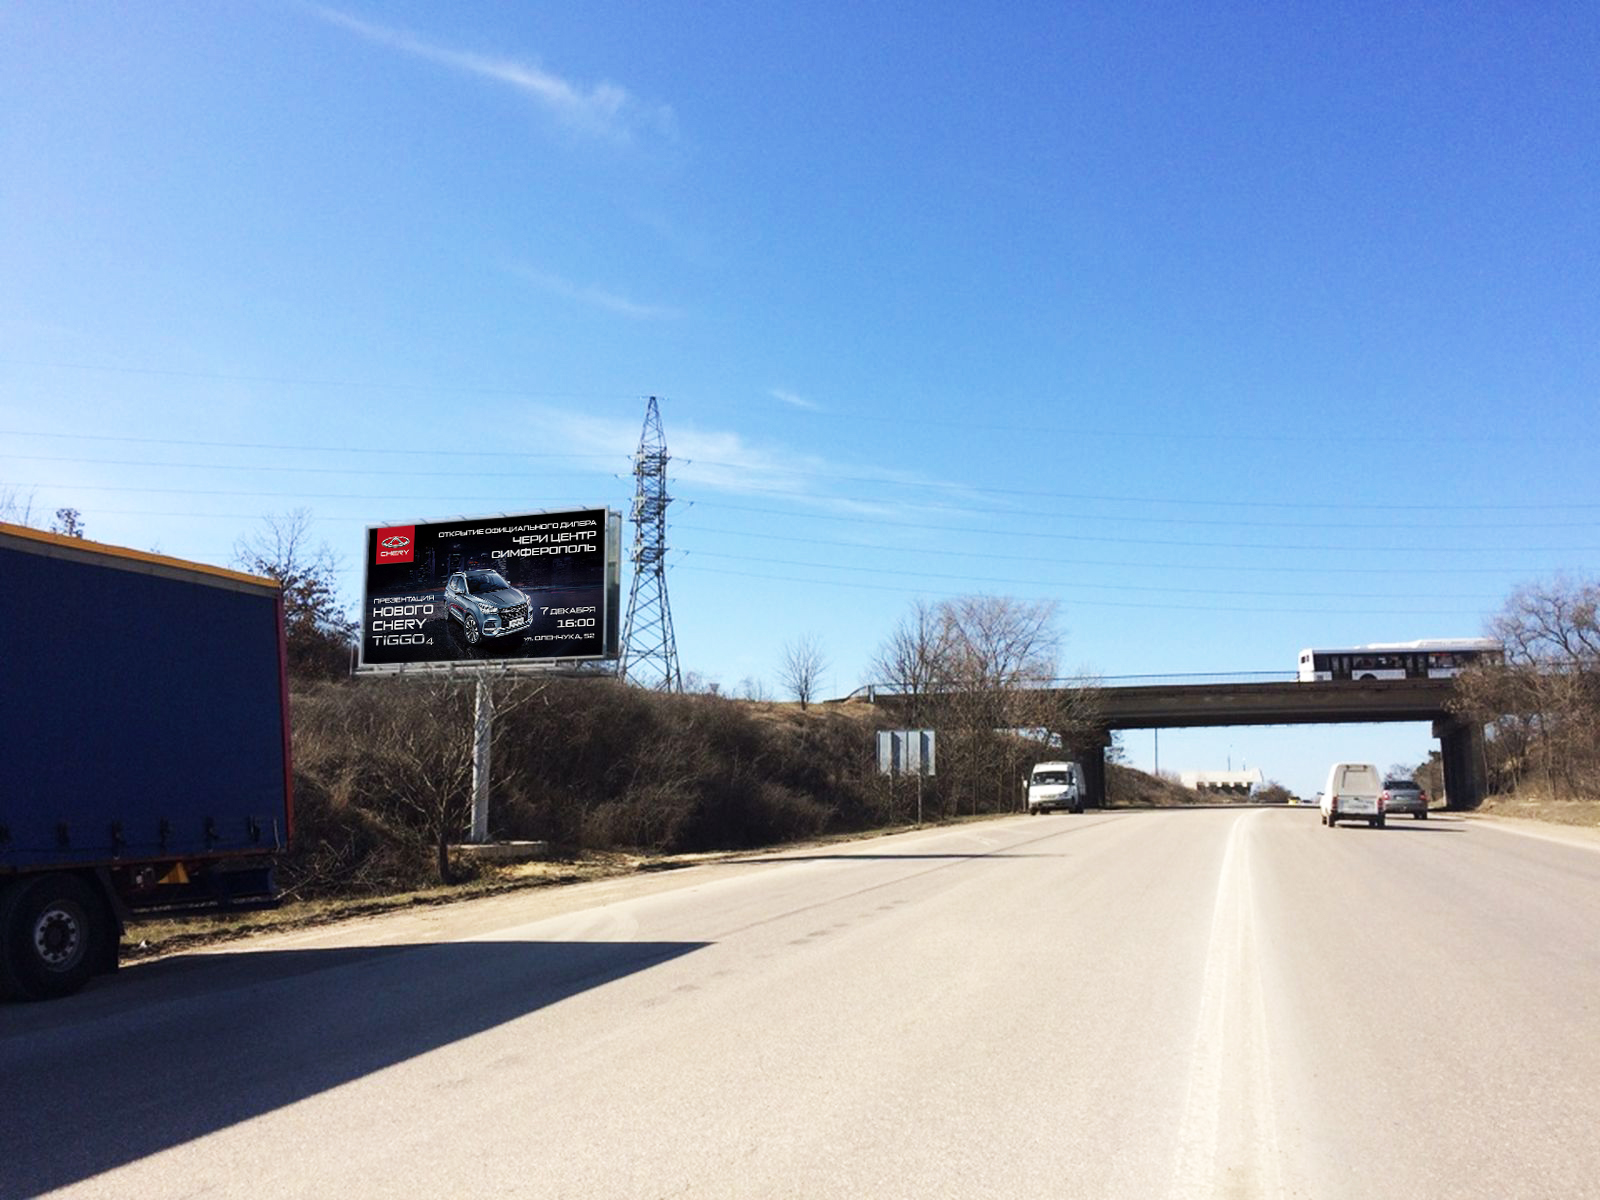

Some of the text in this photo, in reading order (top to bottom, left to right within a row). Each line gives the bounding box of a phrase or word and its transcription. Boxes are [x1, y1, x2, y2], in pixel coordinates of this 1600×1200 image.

[438, 519, 597, 538] ОТКРЫТИЕ ОФИЦИАЛЬНОГО ДИЛЕРА
[512, 530, 597, 545] ЧЕРИ ЦЕНТР
[380, 549, 410, 557] CHERY
[491, 543, 597, 559] СИМФЕРОПОЛЬ
[373, 595, 435, 604] ПРЕЗЕНТАЦИЯ
[373, 604, 434, 617] НОВОГО
[540, 606, 596, 615] 7 ДЕКАБРЯ
[372, 618, 427, 631] CHERY
[557, 618, 595, 628] 16:00
